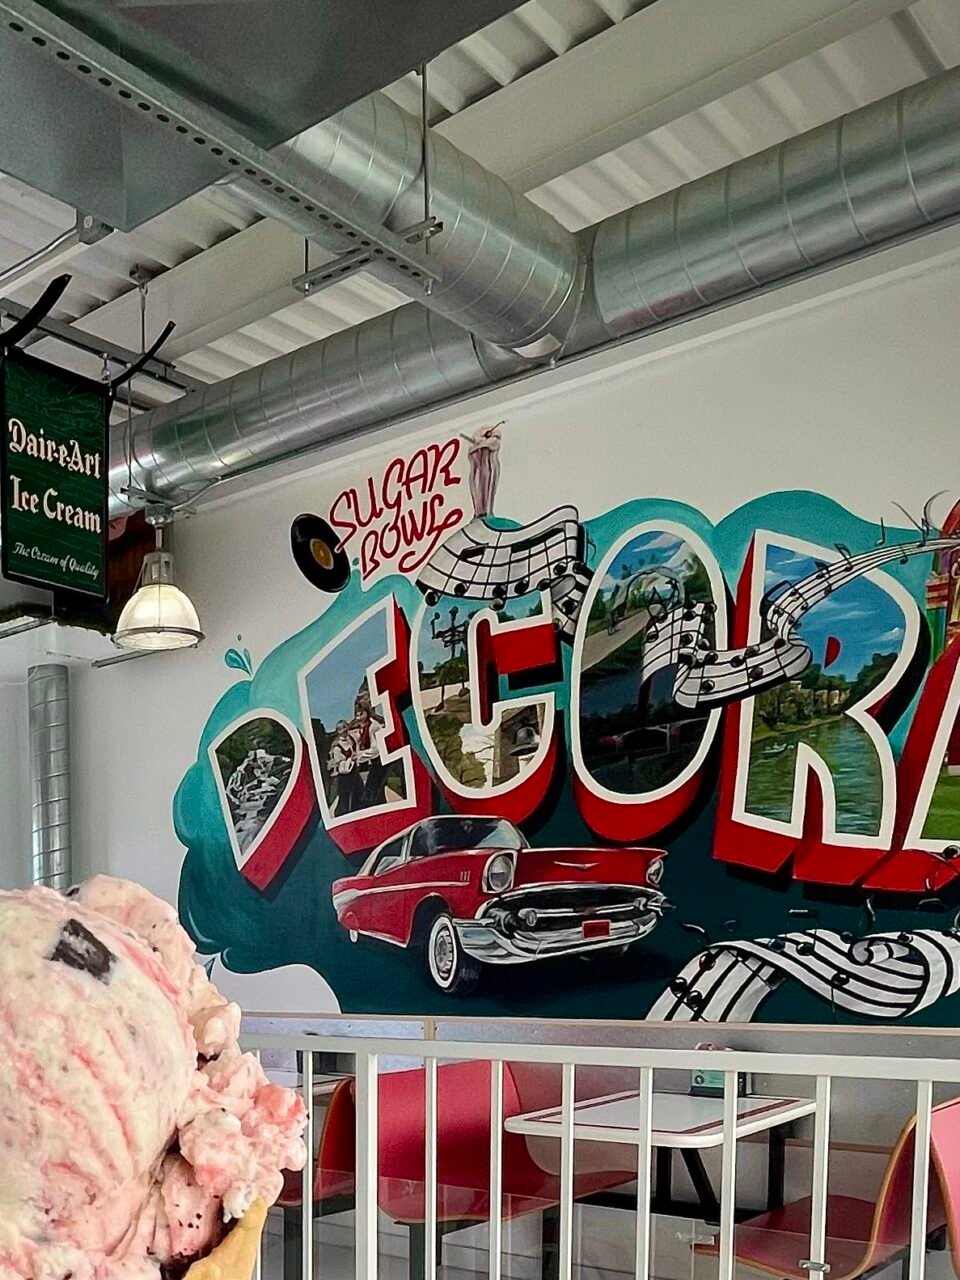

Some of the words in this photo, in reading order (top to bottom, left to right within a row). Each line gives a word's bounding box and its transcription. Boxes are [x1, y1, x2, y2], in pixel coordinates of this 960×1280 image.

[9, 474, 39, 514] Ice
[42, 487, 102, 534] Cream
[329, 438, 462, 553] SUGAR
[12, 541, 30, 558] The
[30, 546, 58, 565] Cream
[59, 554, 69, 572] of
[68, 557, 100, 581] Quality
[361, 493, 464, 582] BOWL
